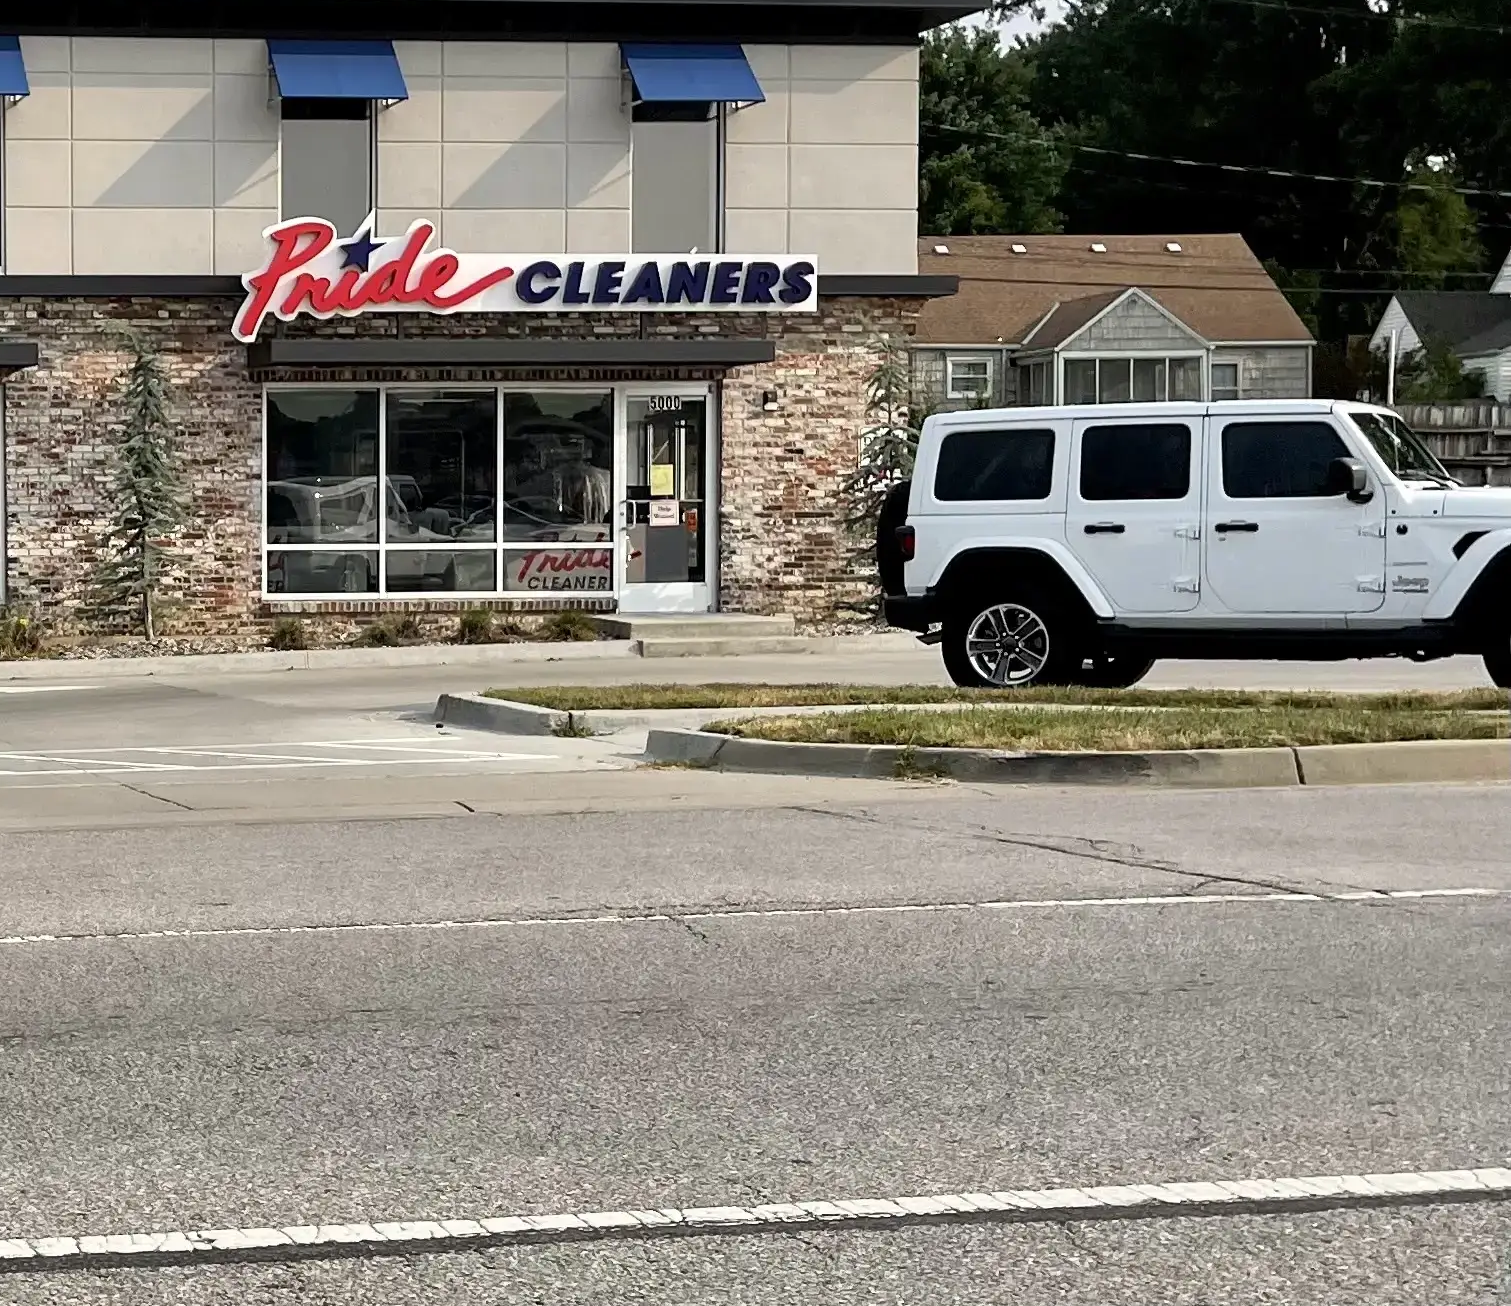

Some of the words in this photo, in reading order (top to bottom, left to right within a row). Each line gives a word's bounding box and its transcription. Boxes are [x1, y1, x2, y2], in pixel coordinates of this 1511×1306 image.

[239, 222, 514, 337] Pride
[515, 260, 815, 304] CLEANERS
[649, 395, 681, 411] 5000
